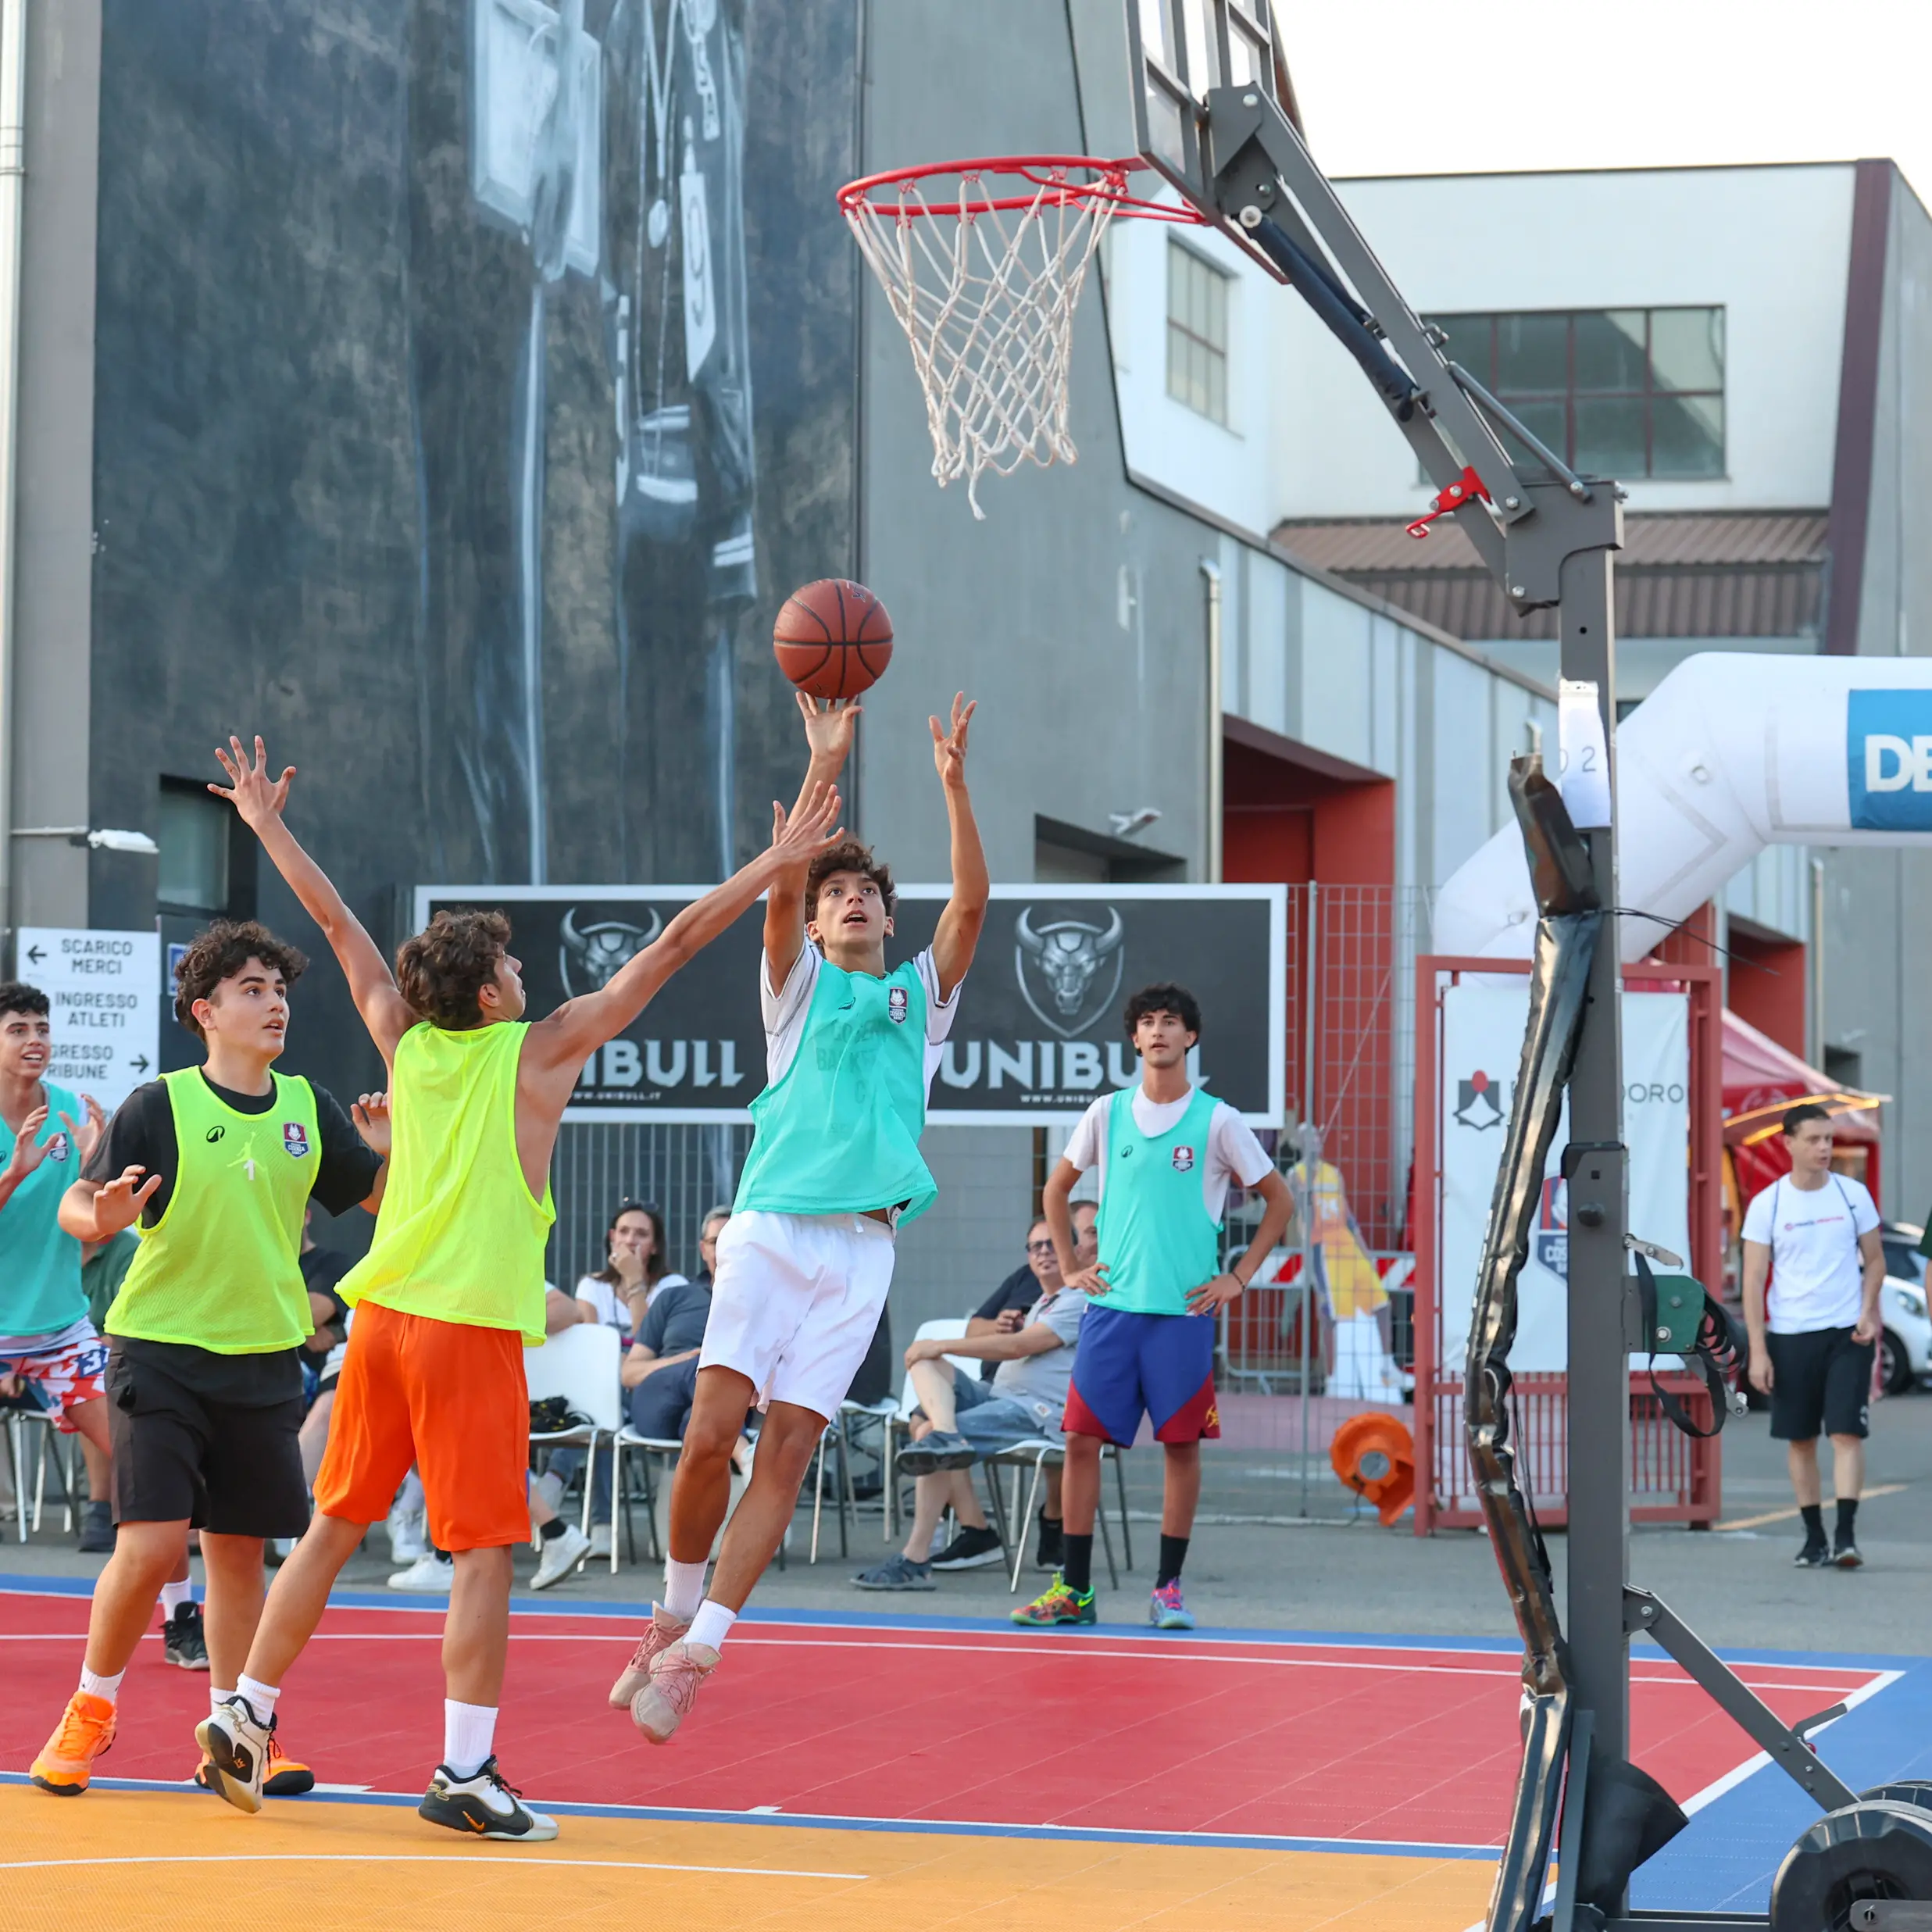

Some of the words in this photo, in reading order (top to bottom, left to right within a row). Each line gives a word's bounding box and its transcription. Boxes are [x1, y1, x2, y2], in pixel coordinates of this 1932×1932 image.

[1865, 734, 1932, 792] DE
[61, 938, 133, 956] SCARICO
[72, 959, 123, 975] MERCI
[55, 991, 137, 1009] INGRESSO
[68, 1011, 126, 1027] ATLETI
[52, 1044, 113, 1060] GRESSO
[47, 1063, 108, 1080] RIBUNE
[580, 1038, 745, 1087] IBULL
[940, 1040, 1211, 1090] UNIBUL
[572, 1091, 662, 1100] WW.UNIBULL.IT
[1020, 1095, 1095, 1104] WWW.UNIBU
[1623, 1084, 1684, 1103] ORO
[244, 1159, 255, 1180] 1
